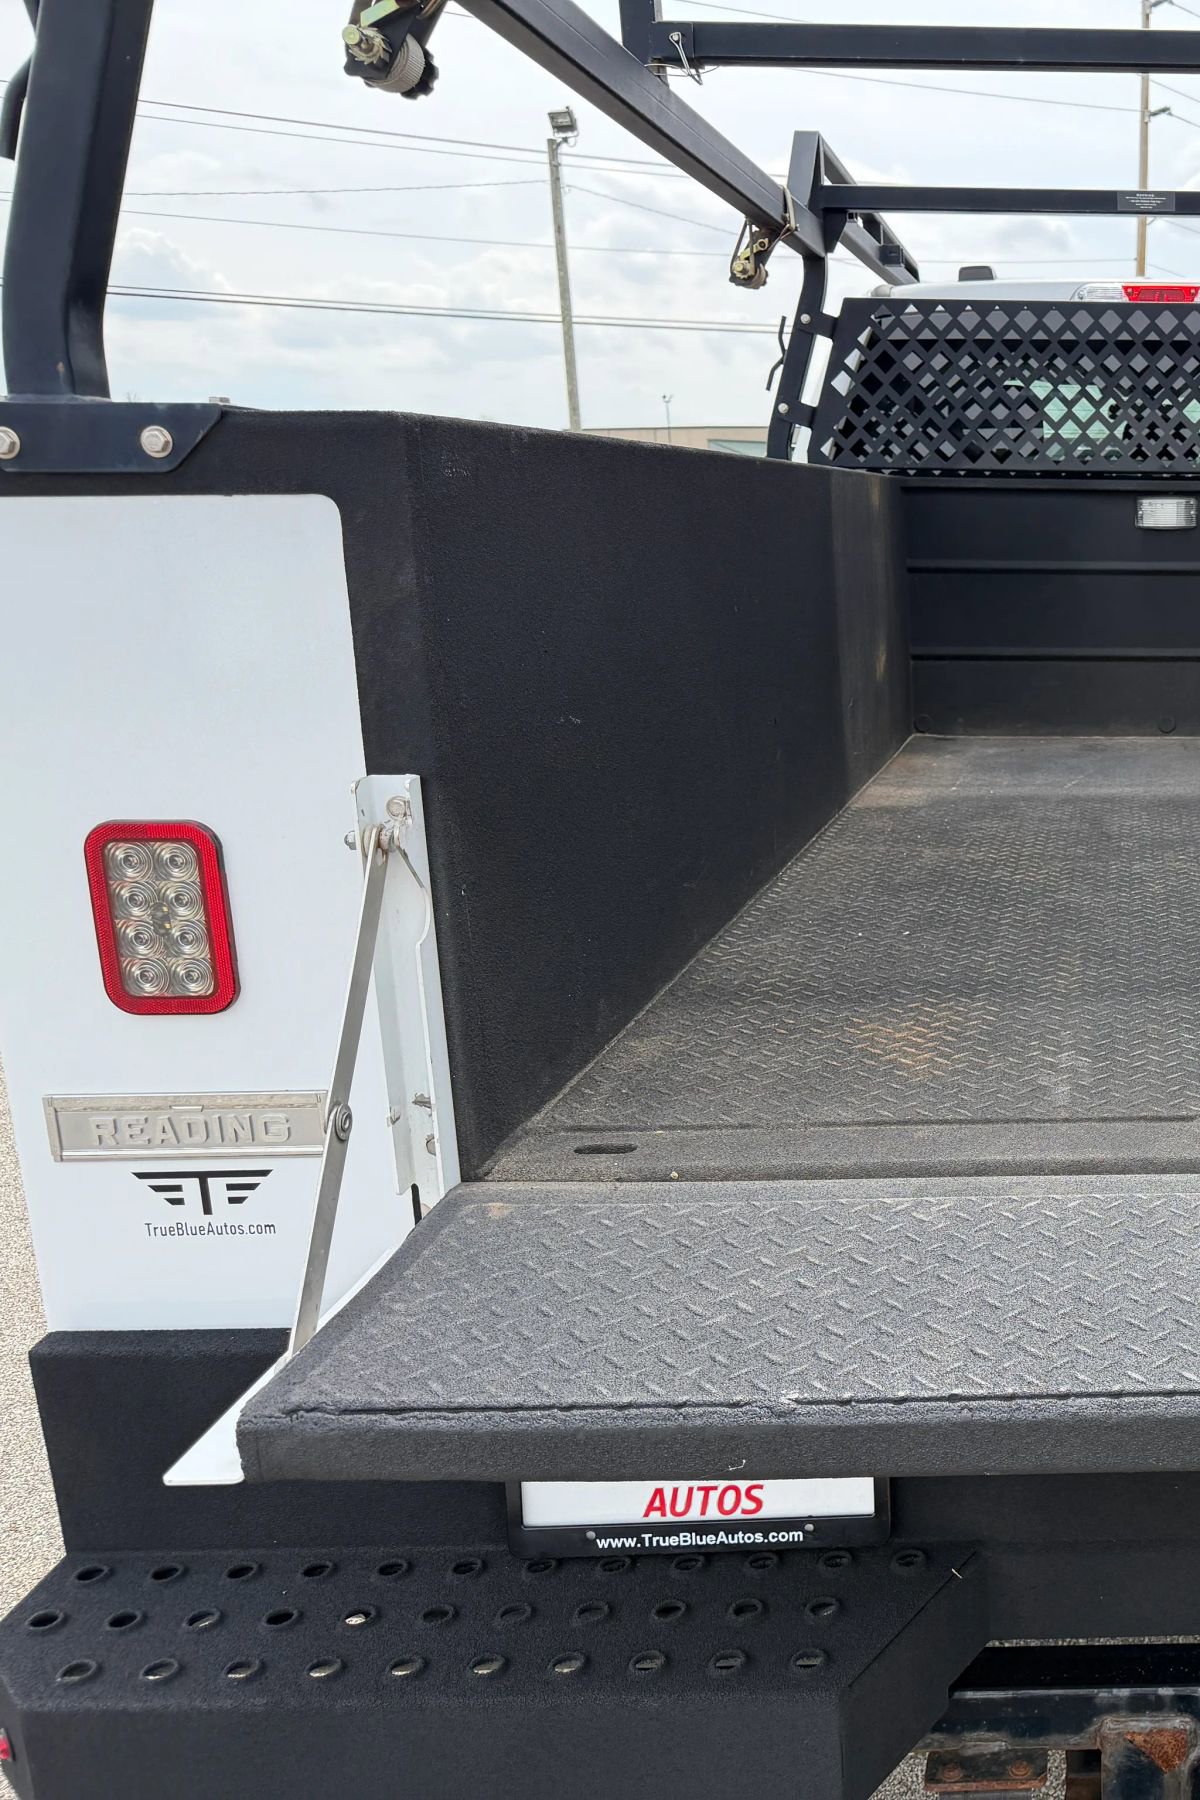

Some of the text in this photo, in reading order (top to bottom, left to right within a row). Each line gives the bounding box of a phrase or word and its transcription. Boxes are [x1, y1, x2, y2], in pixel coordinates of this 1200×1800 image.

[89, 1113, 292, 1146] READING
[144, 1221, 277, 1238] TrueBlueAutos.com
[642, 1483, 765, 1518] AUTOS
[596, 1529, 804, 1550] www.TrueBlueAutos.com
